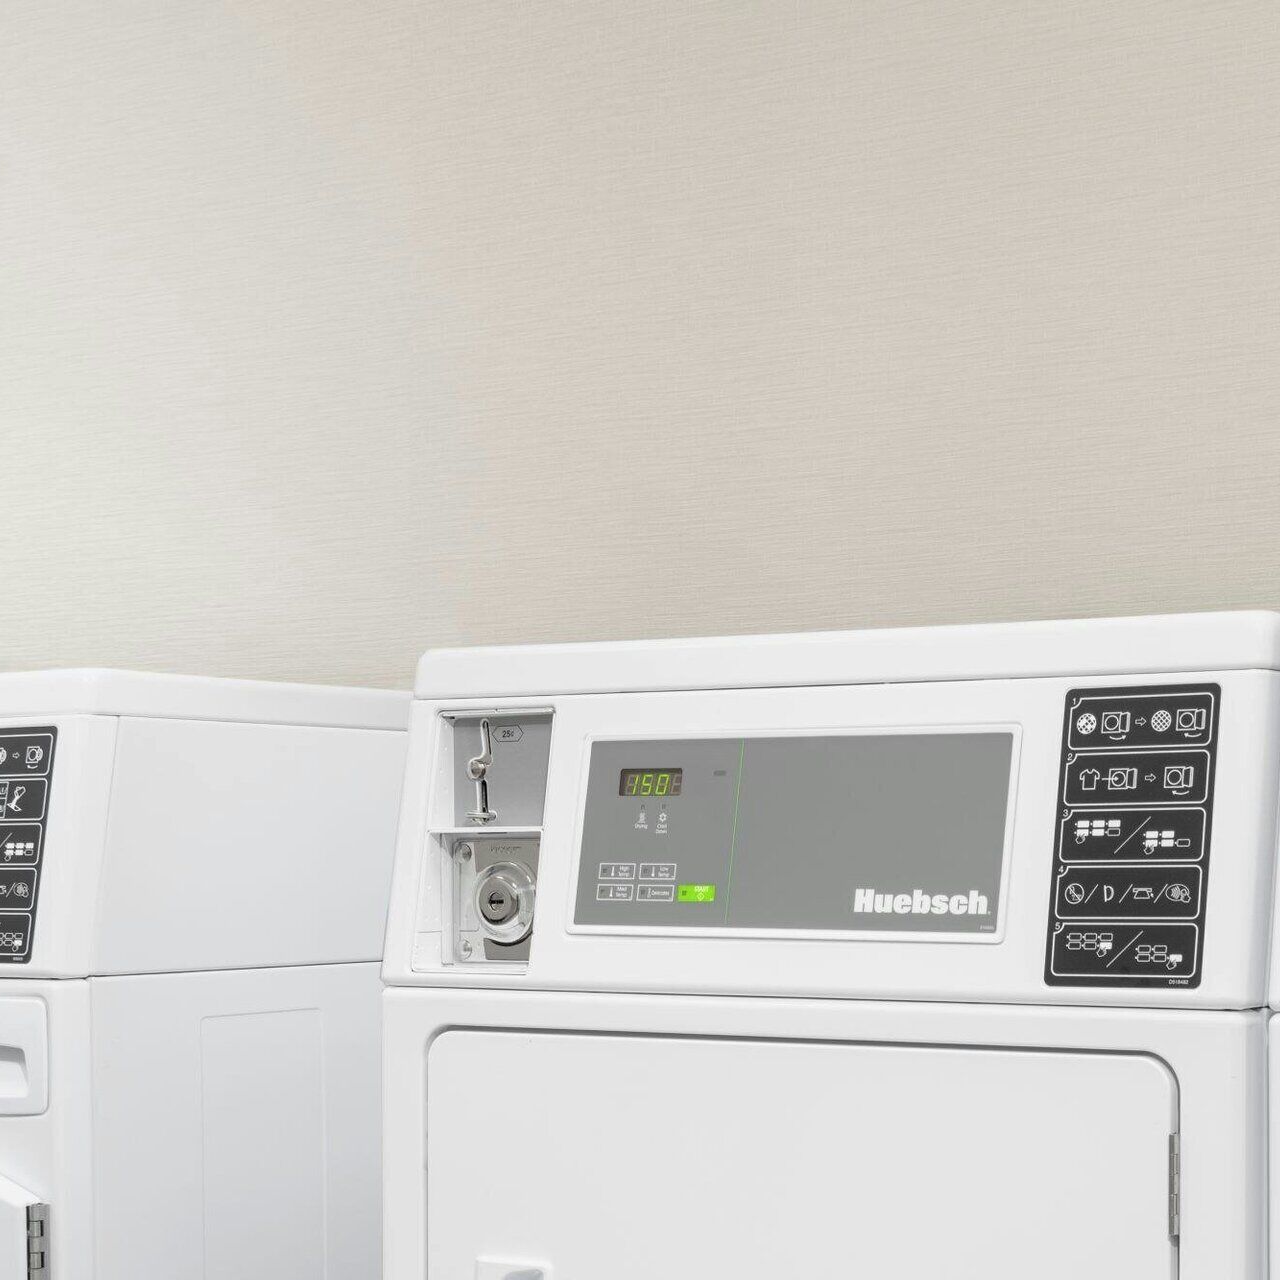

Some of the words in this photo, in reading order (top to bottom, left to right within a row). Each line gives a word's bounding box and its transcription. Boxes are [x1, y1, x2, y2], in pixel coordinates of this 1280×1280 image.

[502, 729, 514, 738] 25¢
[1067, 752, 1073, 761] 2
[632, 774, 670, 795] 150
[1063, 809, 1069, 817] 3
[1058, 865, 1064, 873] 4
[853, 888, 988, 915] Huebsch
[1055, 922, 1061, 930] 5
